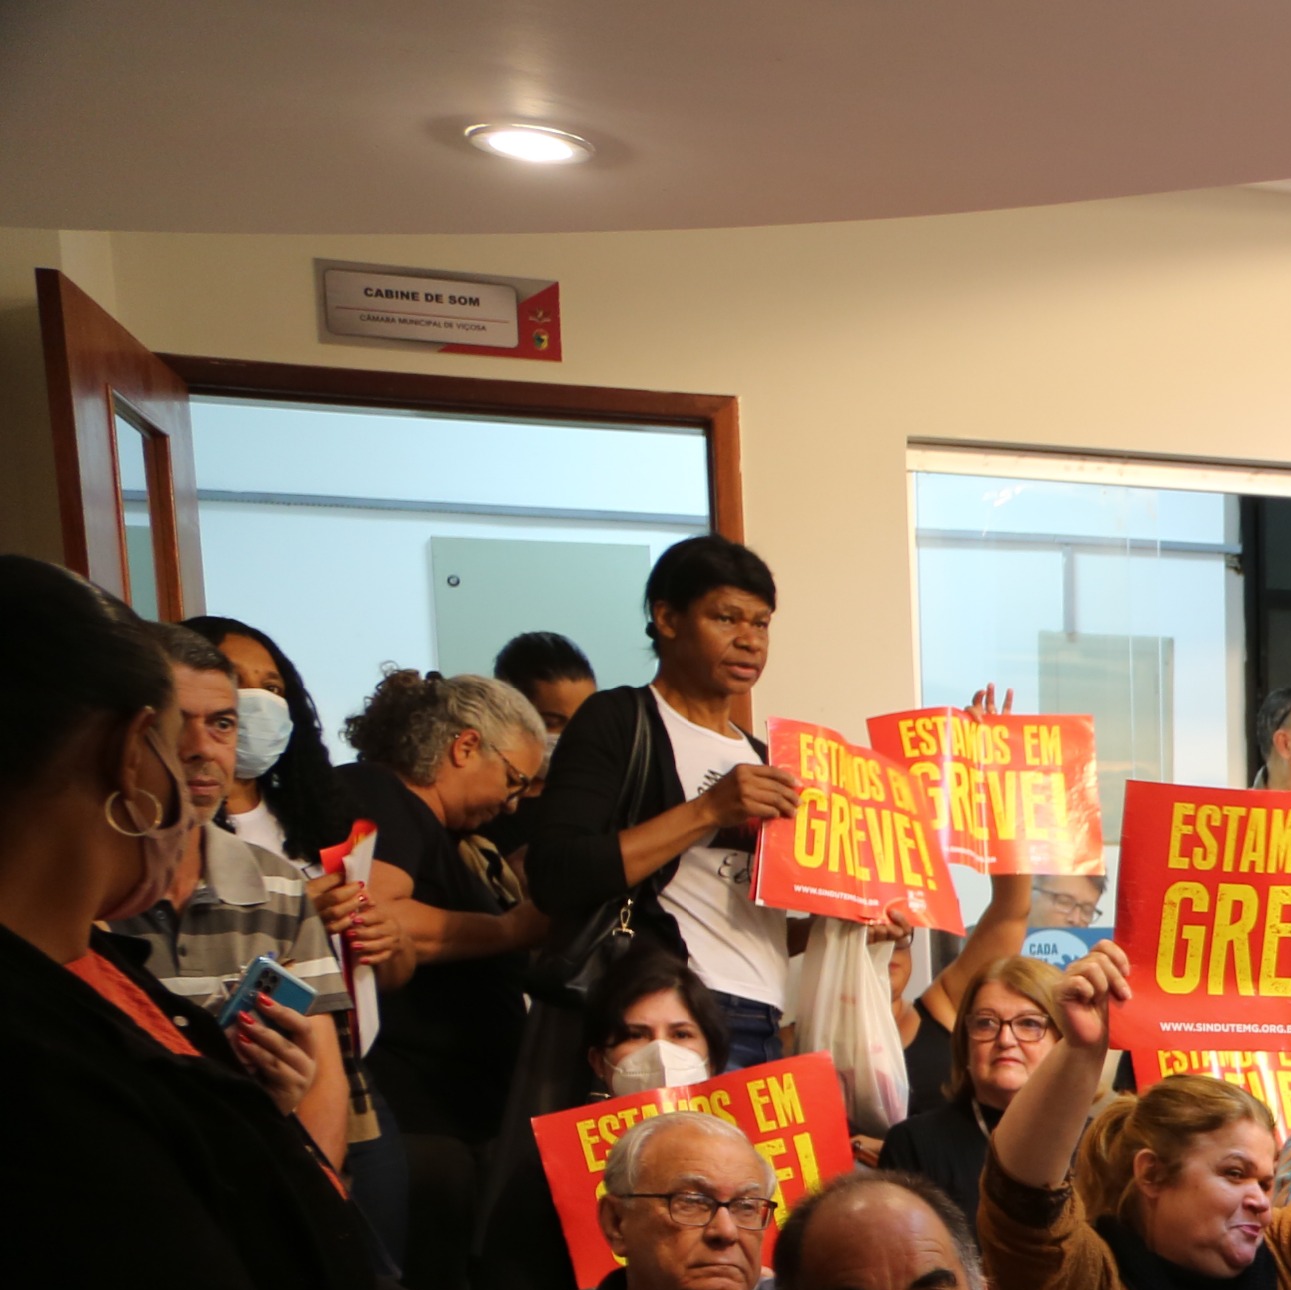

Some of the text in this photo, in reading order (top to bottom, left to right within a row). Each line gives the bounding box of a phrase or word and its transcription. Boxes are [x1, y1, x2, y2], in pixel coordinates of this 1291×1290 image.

[364, 287, 480, 307] CABINE DE SOM
[359, 313, 487, 331] CÂMARA MUNICIPAL DE VIÇOSA
[898, 716, 1063, 766] ESTAMOS EM
[793, 787, 938, 890] GREVE!
[1029, 943, 1059, 956] CADA
[746, 1072, 806, 1133] EM
